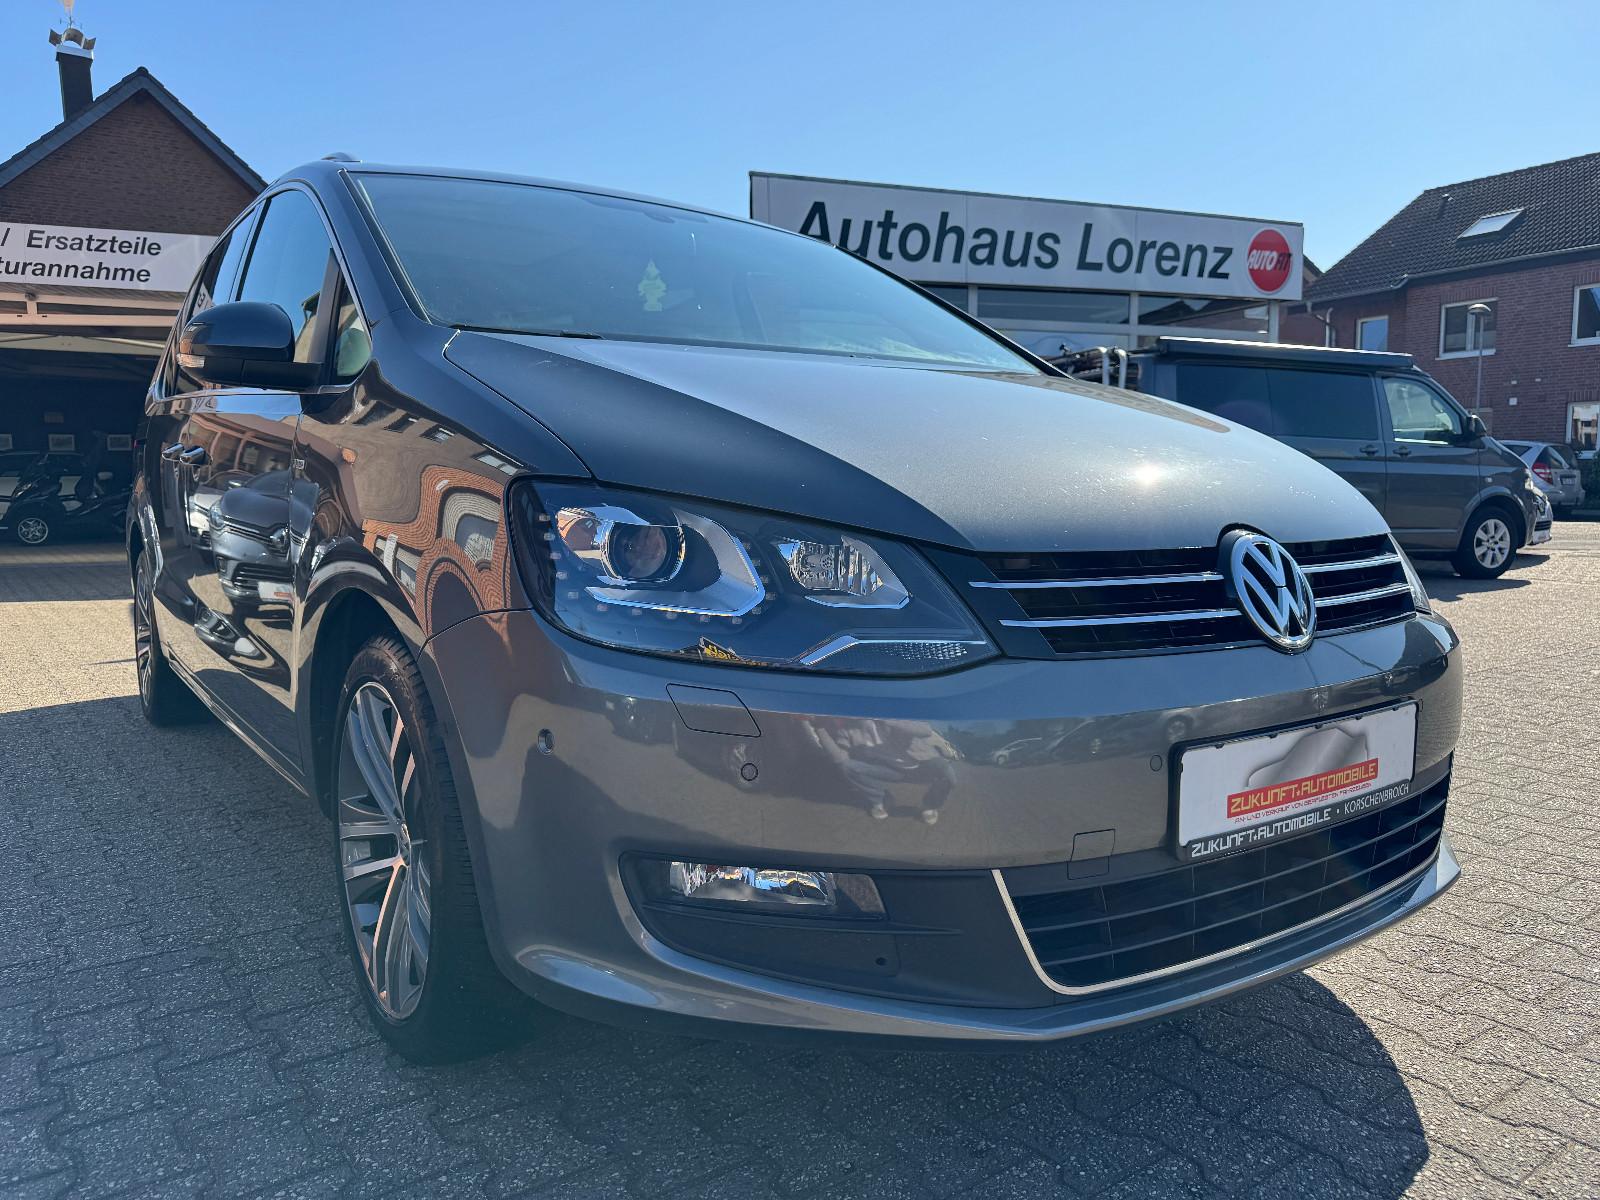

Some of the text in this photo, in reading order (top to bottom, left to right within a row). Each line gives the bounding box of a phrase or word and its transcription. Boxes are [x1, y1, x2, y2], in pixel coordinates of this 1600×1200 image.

[27, 229, 162, 256] Ersatzteile
[799, 201, 1232, 280] Autohaus Lorenz
[1344, 783, 1409, 815] KORSCHENBROICH
